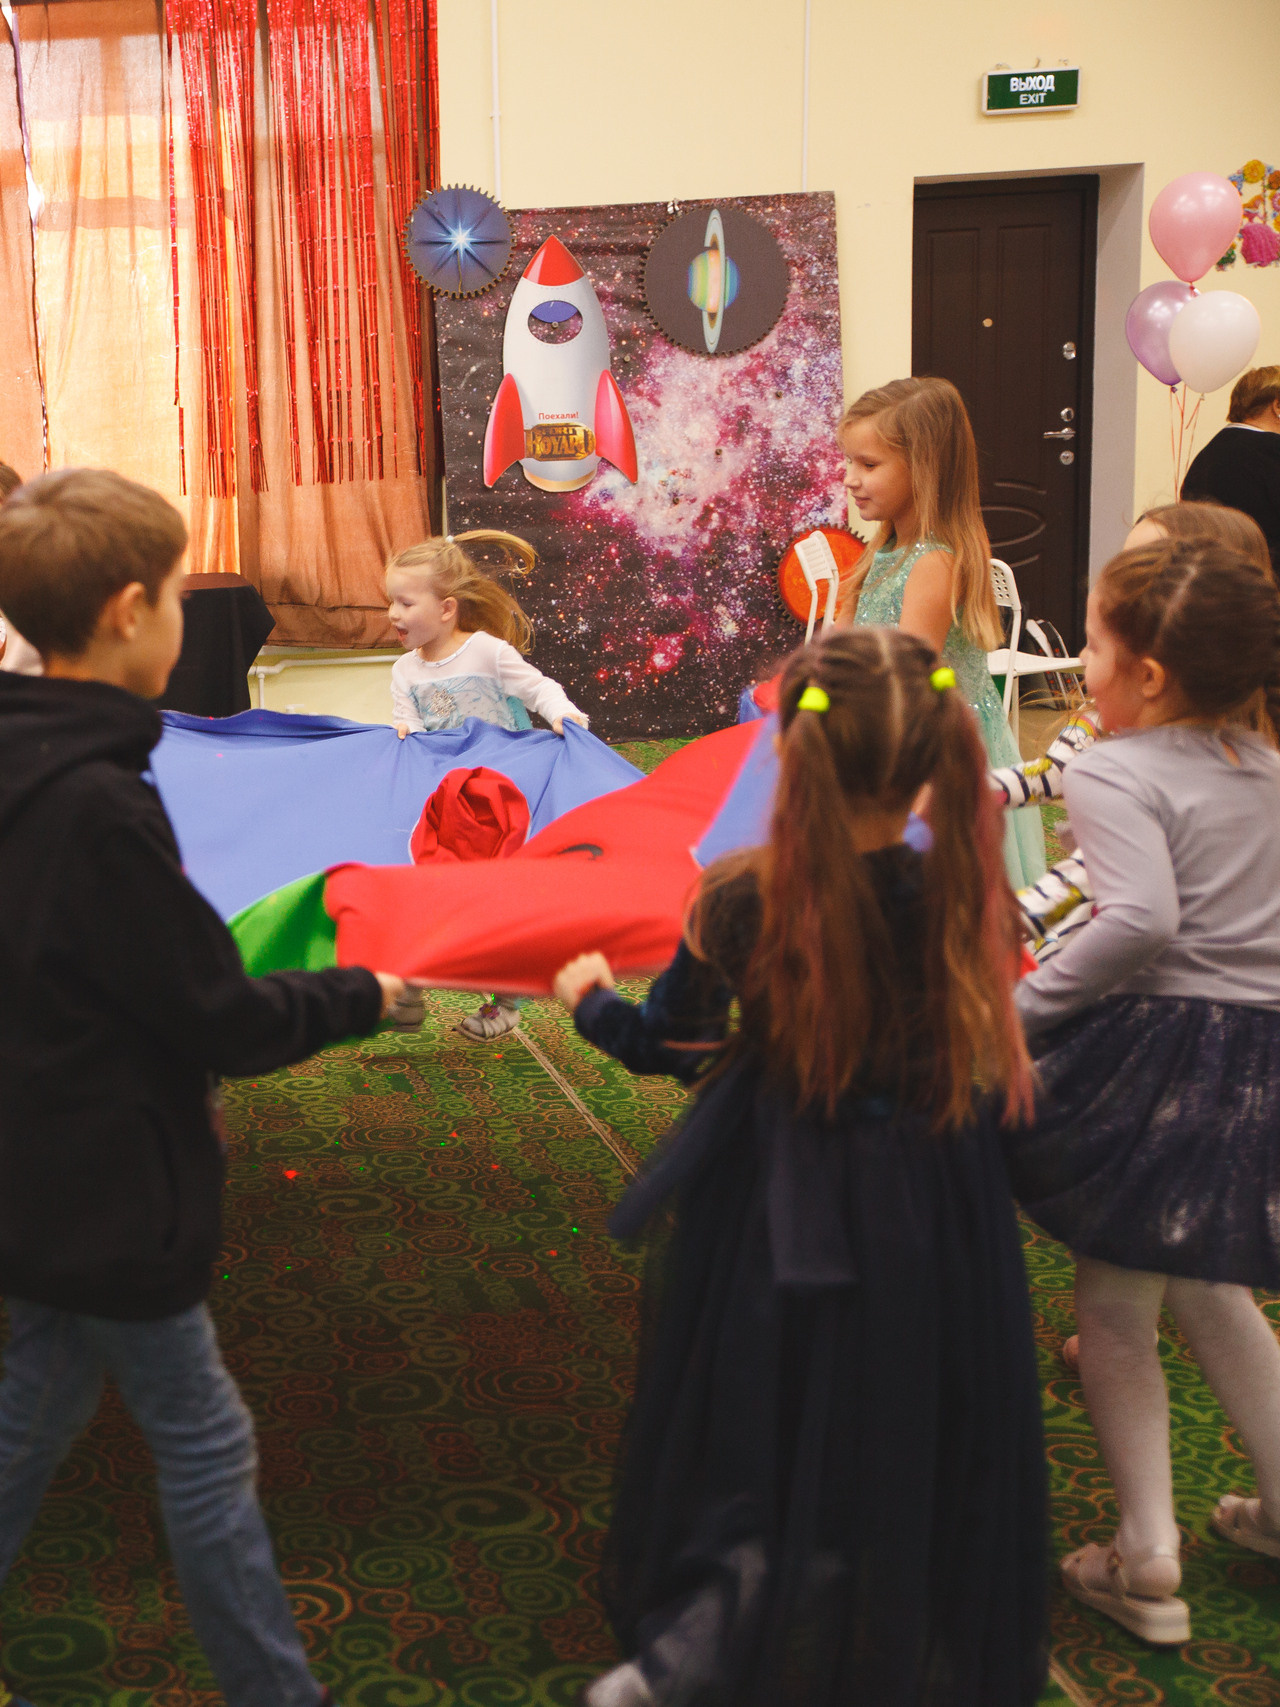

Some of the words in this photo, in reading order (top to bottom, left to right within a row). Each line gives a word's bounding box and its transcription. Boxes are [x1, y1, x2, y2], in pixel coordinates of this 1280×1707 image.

[1009, 74, 1055, 92] ВЫХОД
[1019, 92, 1046, 105] EXIT
[538, 411, 579, 420] Поехали!
